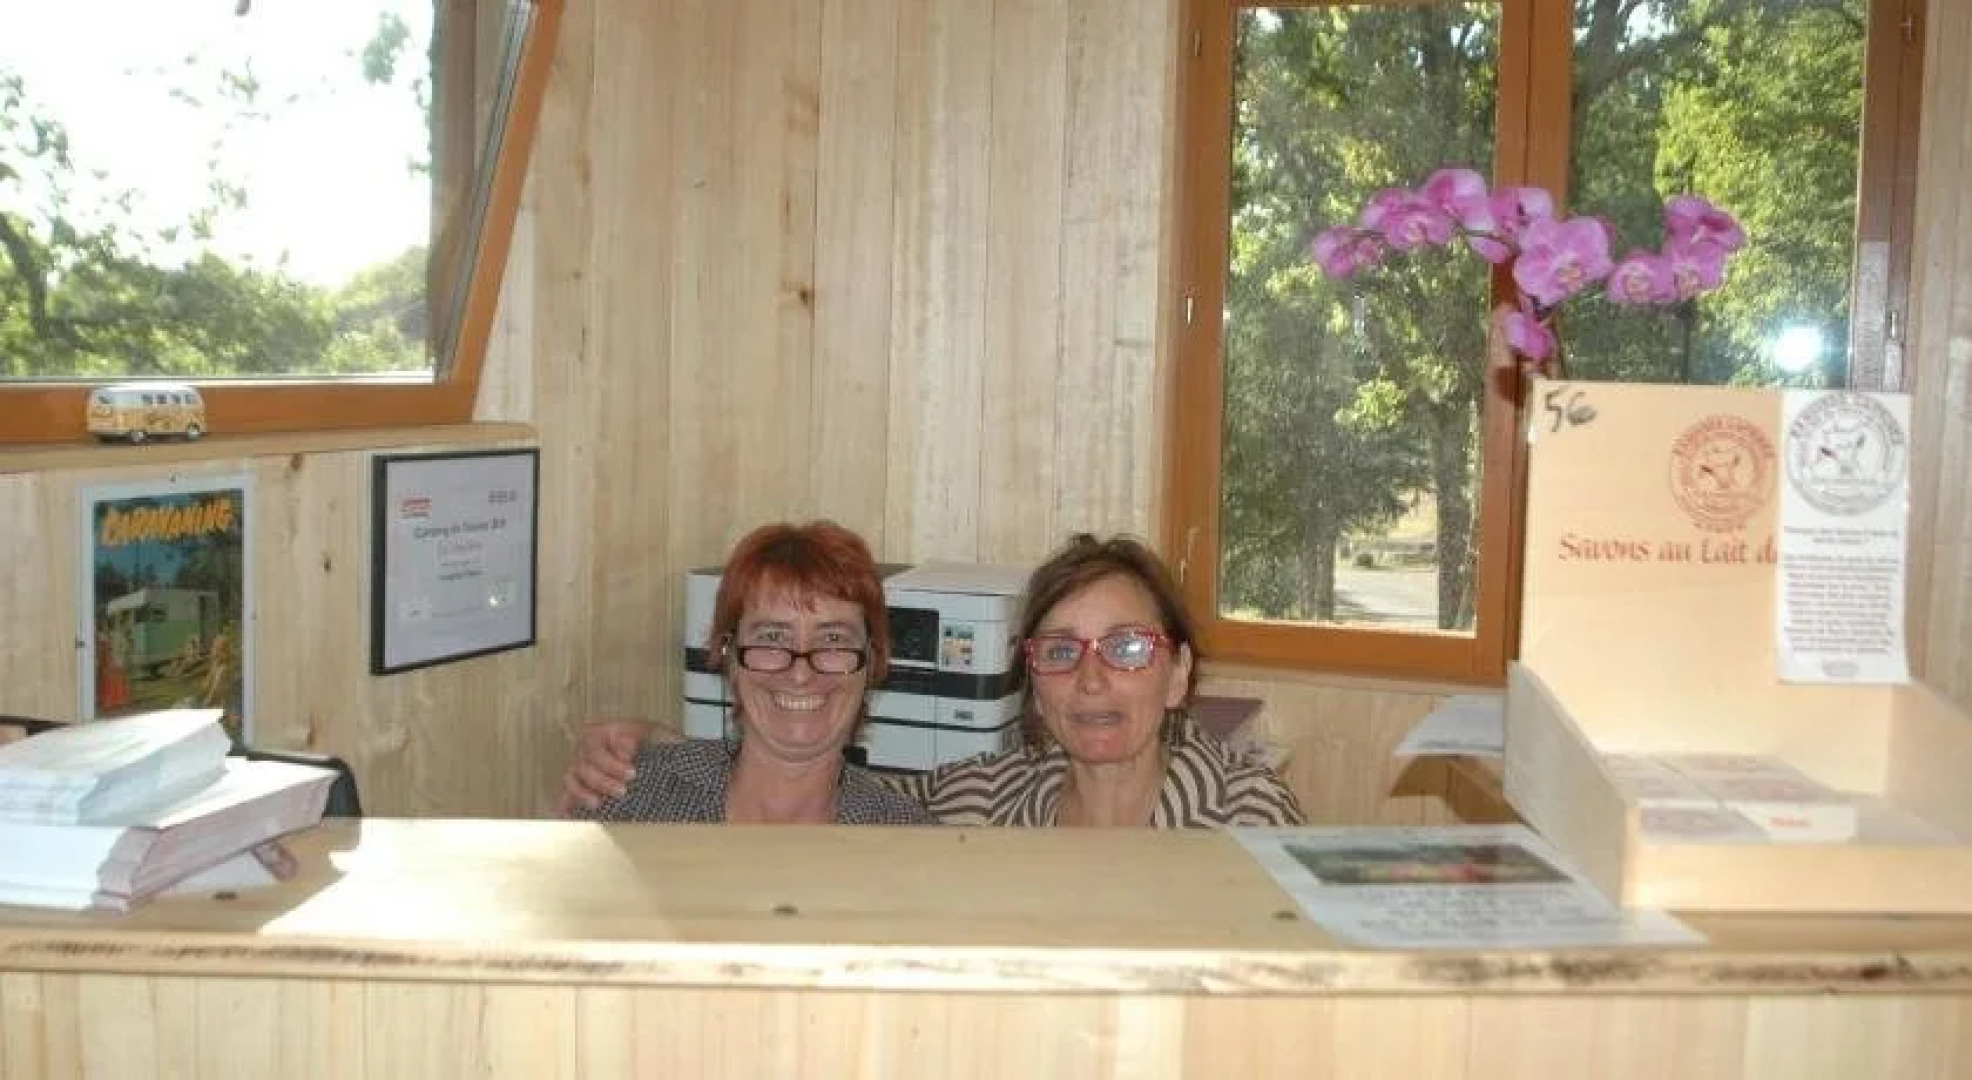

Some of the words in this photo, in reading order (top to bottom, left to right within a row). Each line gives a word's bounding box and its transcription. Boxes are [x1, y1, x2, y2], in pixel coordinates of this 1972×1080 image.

[102, 497, 234, 546] CARAVANING
[1558, 533, 1649, 562] Savons
[1659, 541, 1691, 562] au
